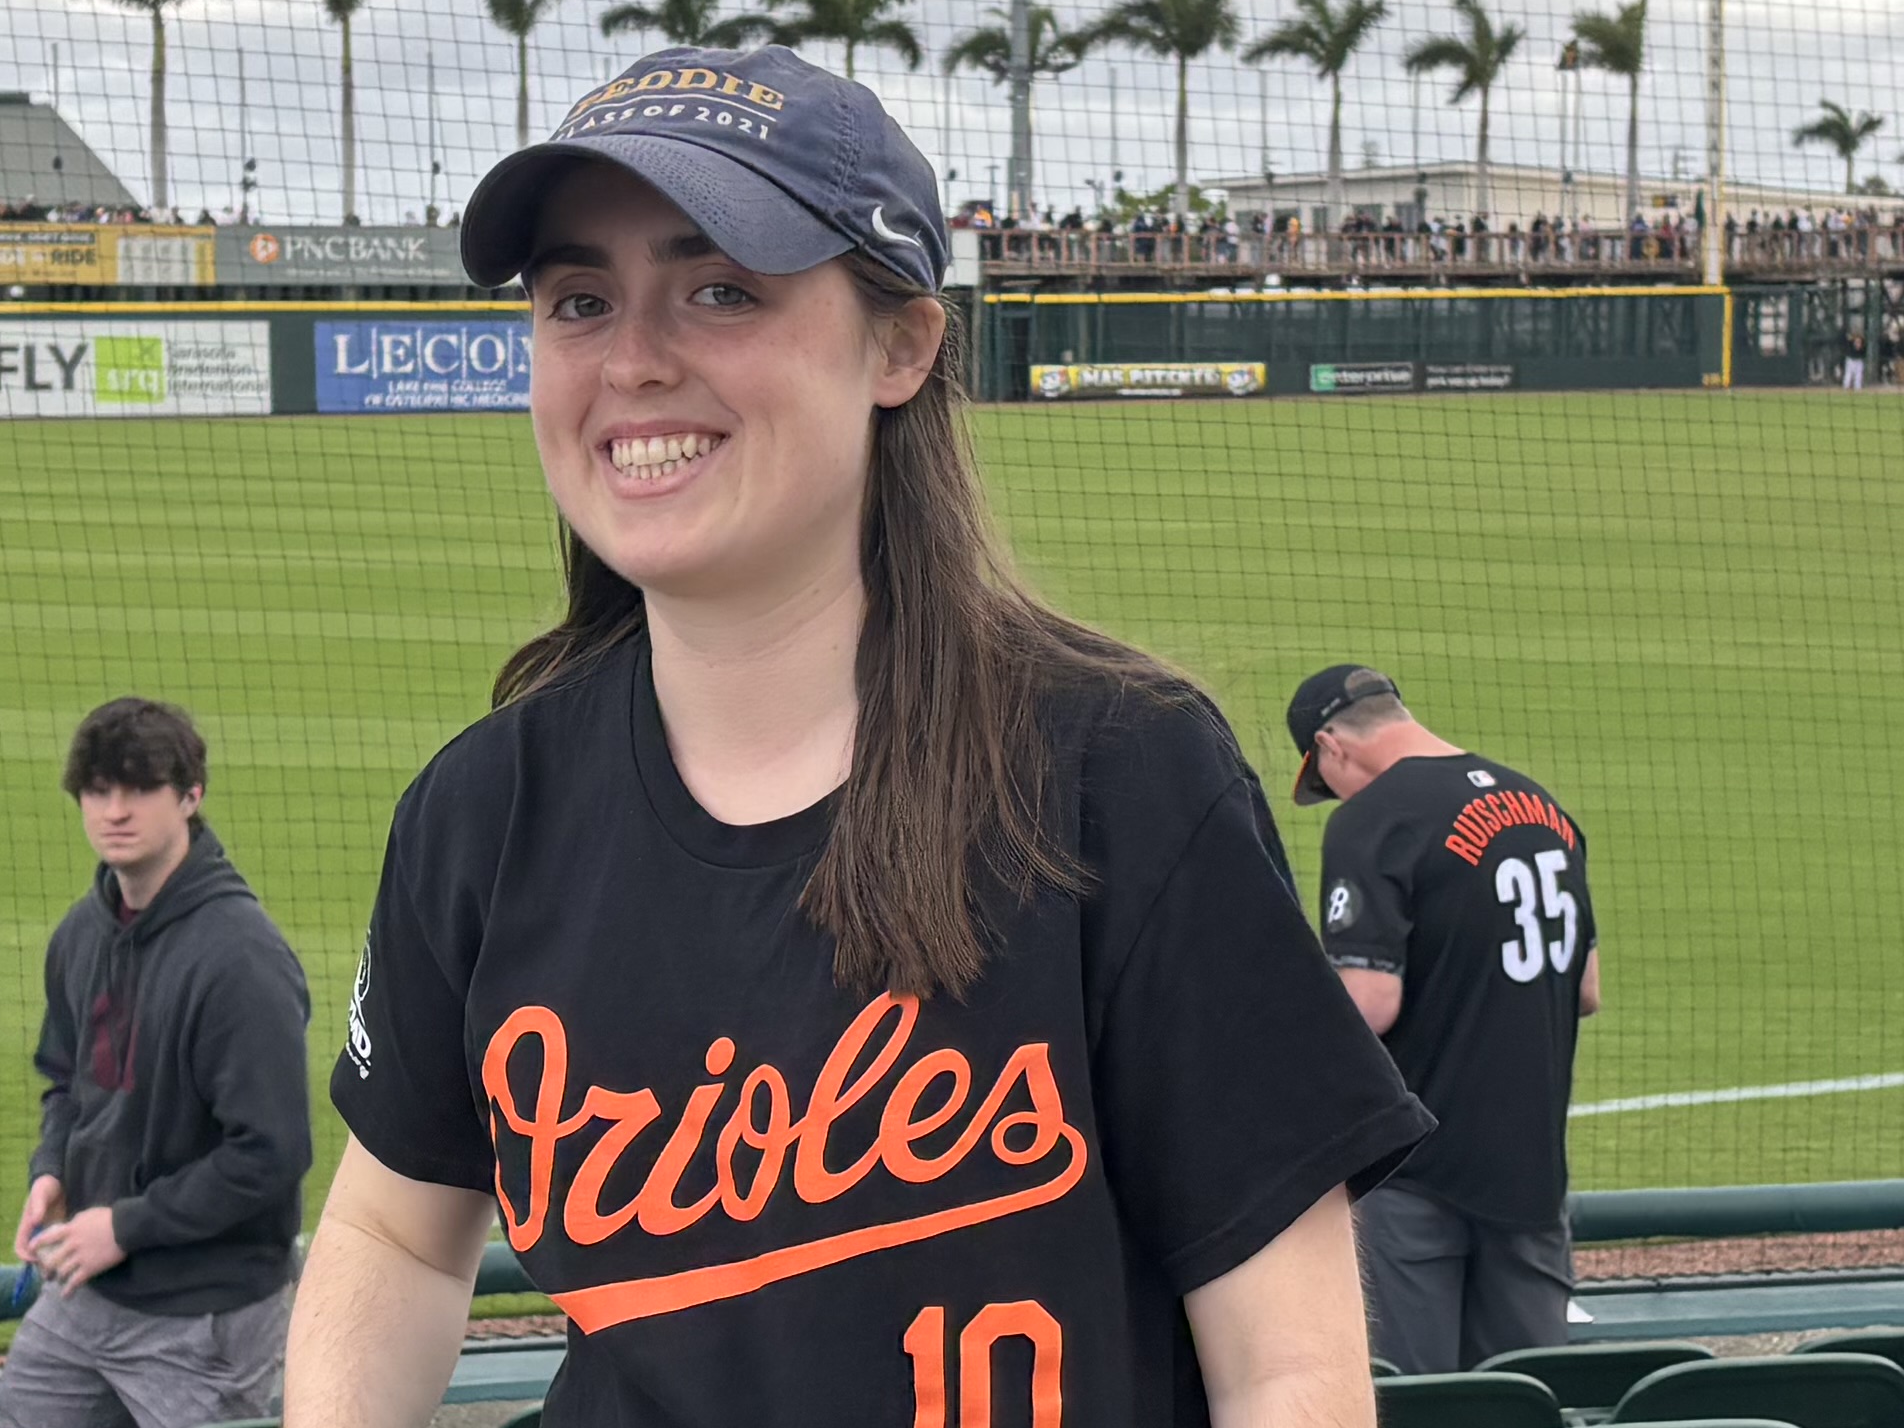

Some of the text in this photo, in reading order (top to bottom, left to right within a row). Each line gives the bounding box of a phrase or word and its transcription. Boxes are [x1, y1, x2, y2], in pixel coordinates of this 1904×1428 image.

[643, 104, 685, 117] OF
[694, 106, 769, 140] 2021
[1495, 848, 1578, 982] 35
[482, 990, 1088, 1254] Orioles
